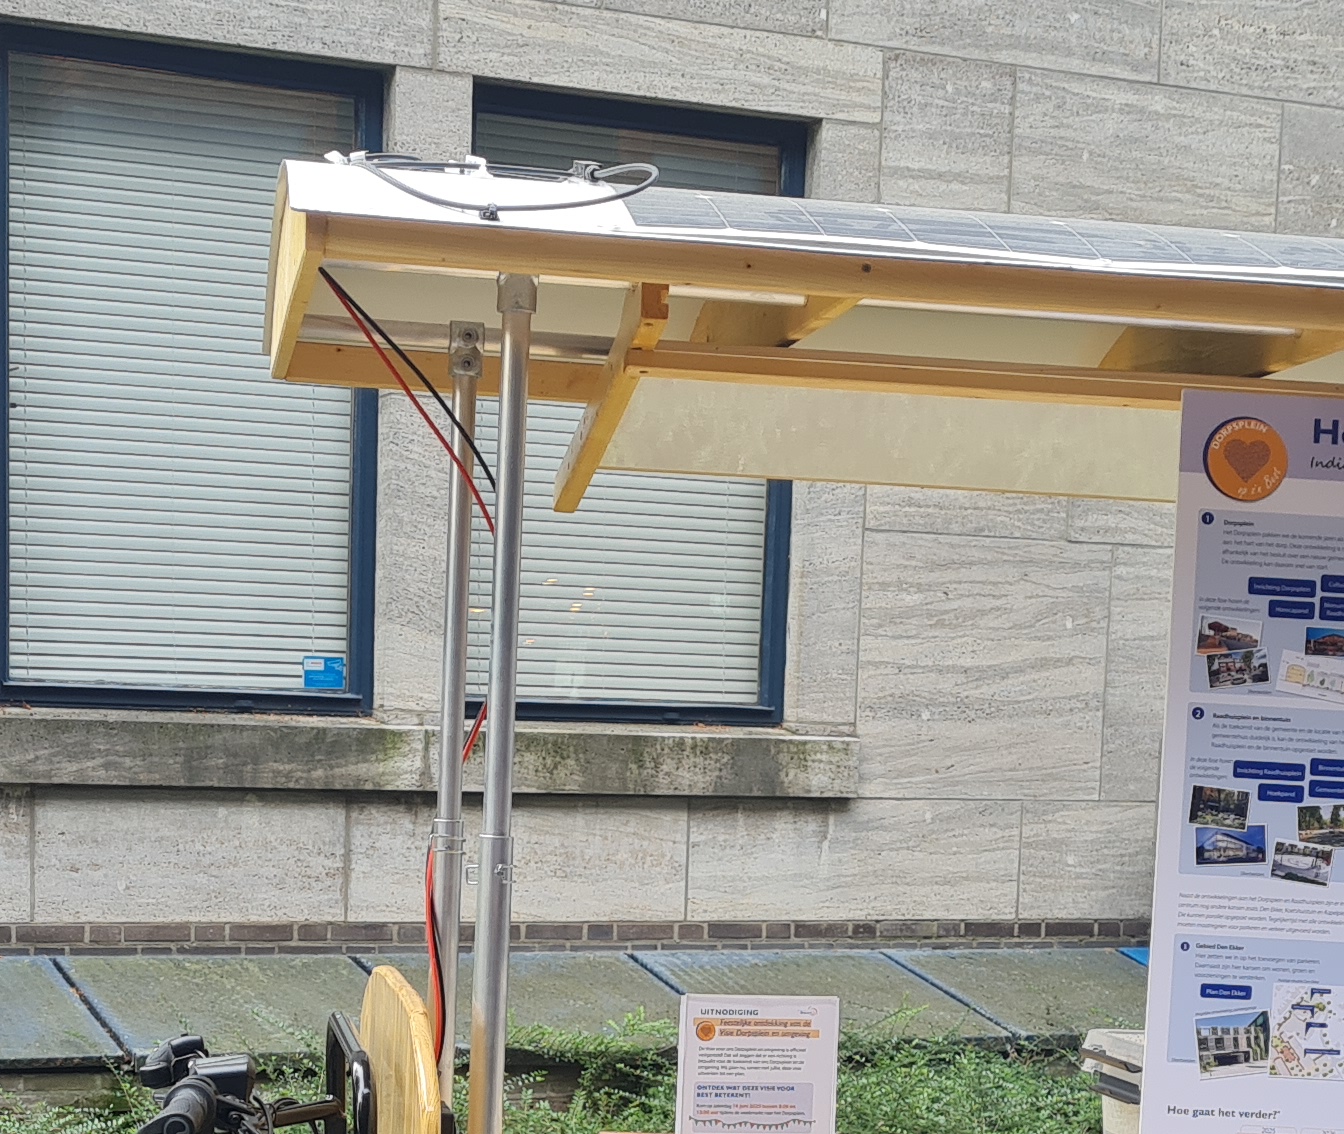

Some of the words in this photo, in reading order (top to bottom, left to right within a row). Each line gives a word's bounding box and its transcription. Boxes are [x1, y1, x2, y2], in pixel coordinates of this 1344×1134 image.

[1211, 420, 1269, 450] DORPSPLEIN
[700, 1008, 759, 1016] UITNODIGING
[1167, 1105, 1189, 1115] Hoe
[1192, 1109, 1215, 1118] gaat
[1218, 1108, 1235, 1117] het
